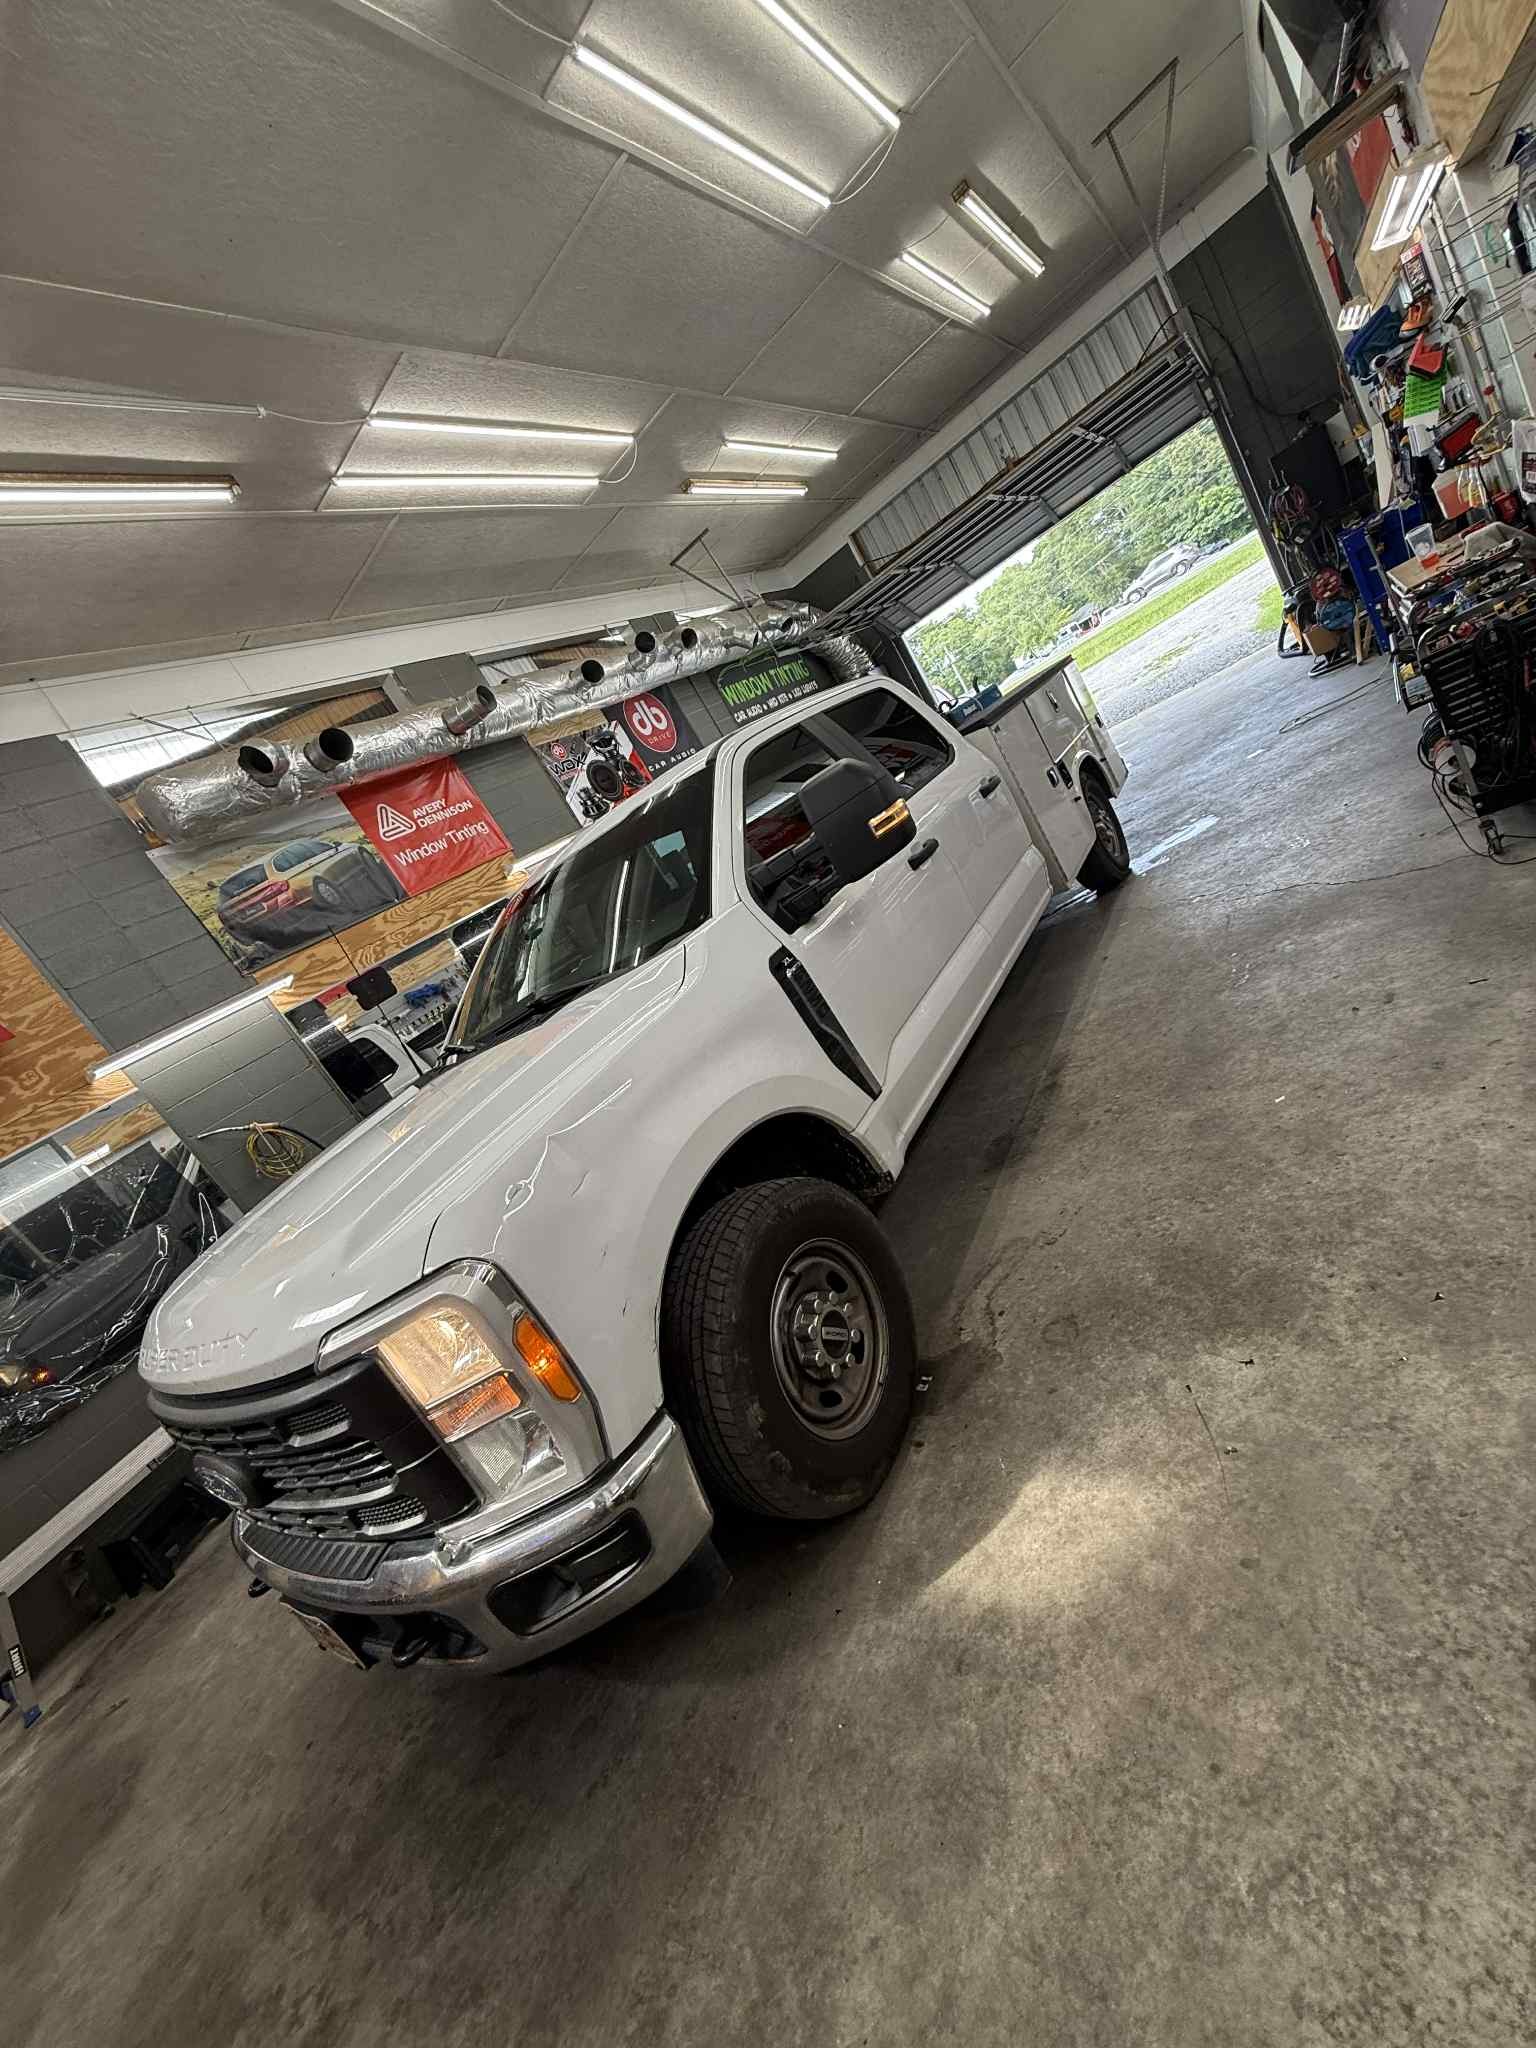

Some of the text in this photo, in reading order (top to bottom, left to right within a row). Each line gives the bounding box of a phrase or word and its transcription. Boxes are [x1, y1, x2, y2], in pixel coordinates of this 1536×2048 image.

[721, 659, 810, 706] WINDOW TINTING
[632, 700, 668, 736] db
[734, 710, 747, 723] CAR
[746, 703, 763, 718] AUDIO
[647, 731, 671, 745] DRIVE
[648, 747, 696, 772] CAR AUDIO
[412, 798, 447, 819] AVERY
[417, 799, 474, 828] DENNISON
[394, 821, 489, 866] Window Tinting
